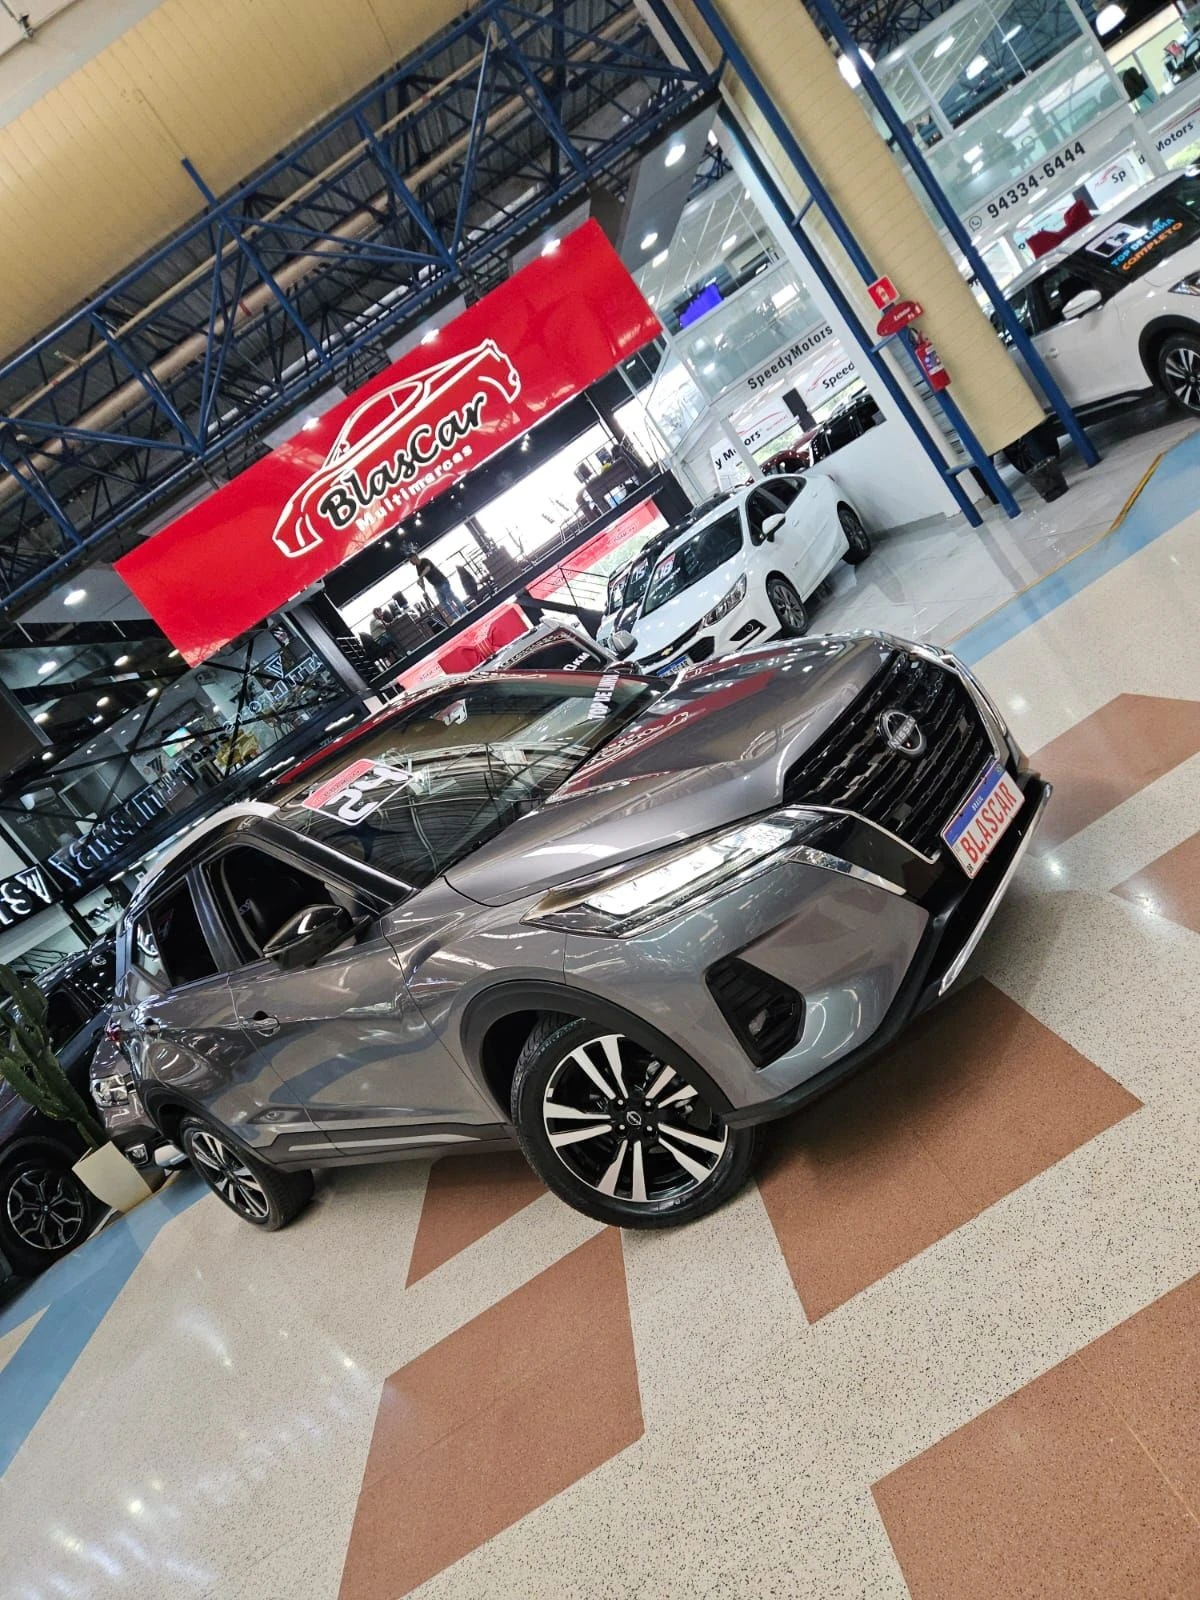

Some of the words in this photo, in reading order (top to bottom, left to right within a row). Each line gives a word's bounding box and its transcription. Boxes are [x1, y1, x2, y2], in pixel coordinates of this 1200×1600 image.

[987, 141, 1086, 219] 94334-6444
[1110, 247, 1131, 267] TOP
[1121, 222, 1184, 271] COMPLETO
[747, 325, 834, 390] SpeedyMotors
[319, 394, 486, 528] BlasCar
[355, 444, 473, 531] Multimarcas
[587, 702, 609, 720] TOP
[324, 765, 410, 821] 24
[959, 783, 1018, 864] BLASCAR
